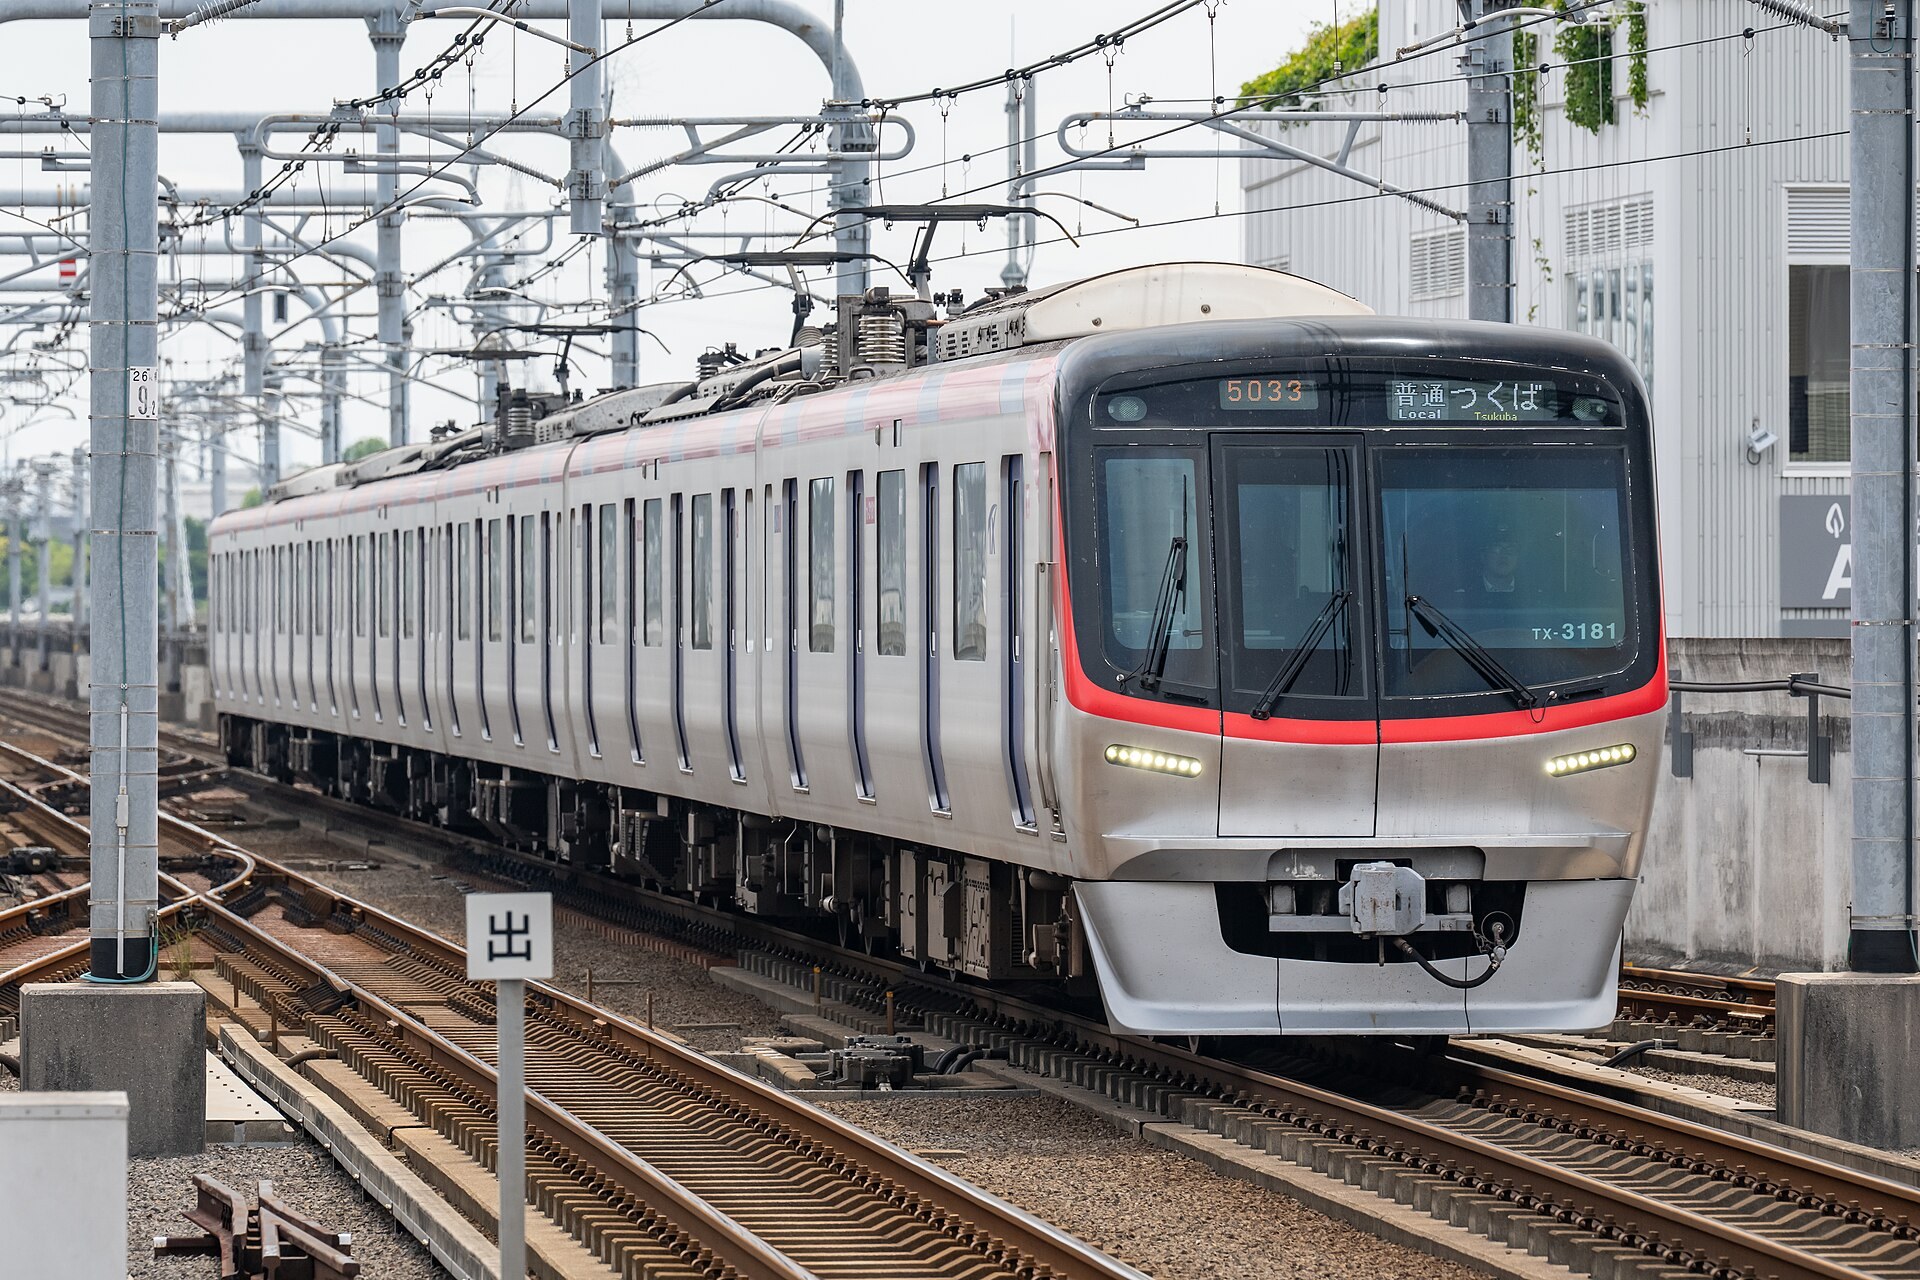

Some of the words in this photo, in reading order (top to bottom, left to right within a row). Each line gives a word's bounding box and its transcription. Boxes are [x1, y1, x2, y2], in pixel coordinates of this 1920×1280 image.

[133, 370, 148, 382] 26
[1228, 380, 1301, 401] 5033
[1394, 382, 1446, 407] 普通
[1450, 382, 1542, 411] つくば
[1399, 409, 1441, 419] Local
[1474, 411, 1518, 421] Tsukuba
[1532, 622, 1616, 640] TX-3181
[488, 910, 531, 962] 出
